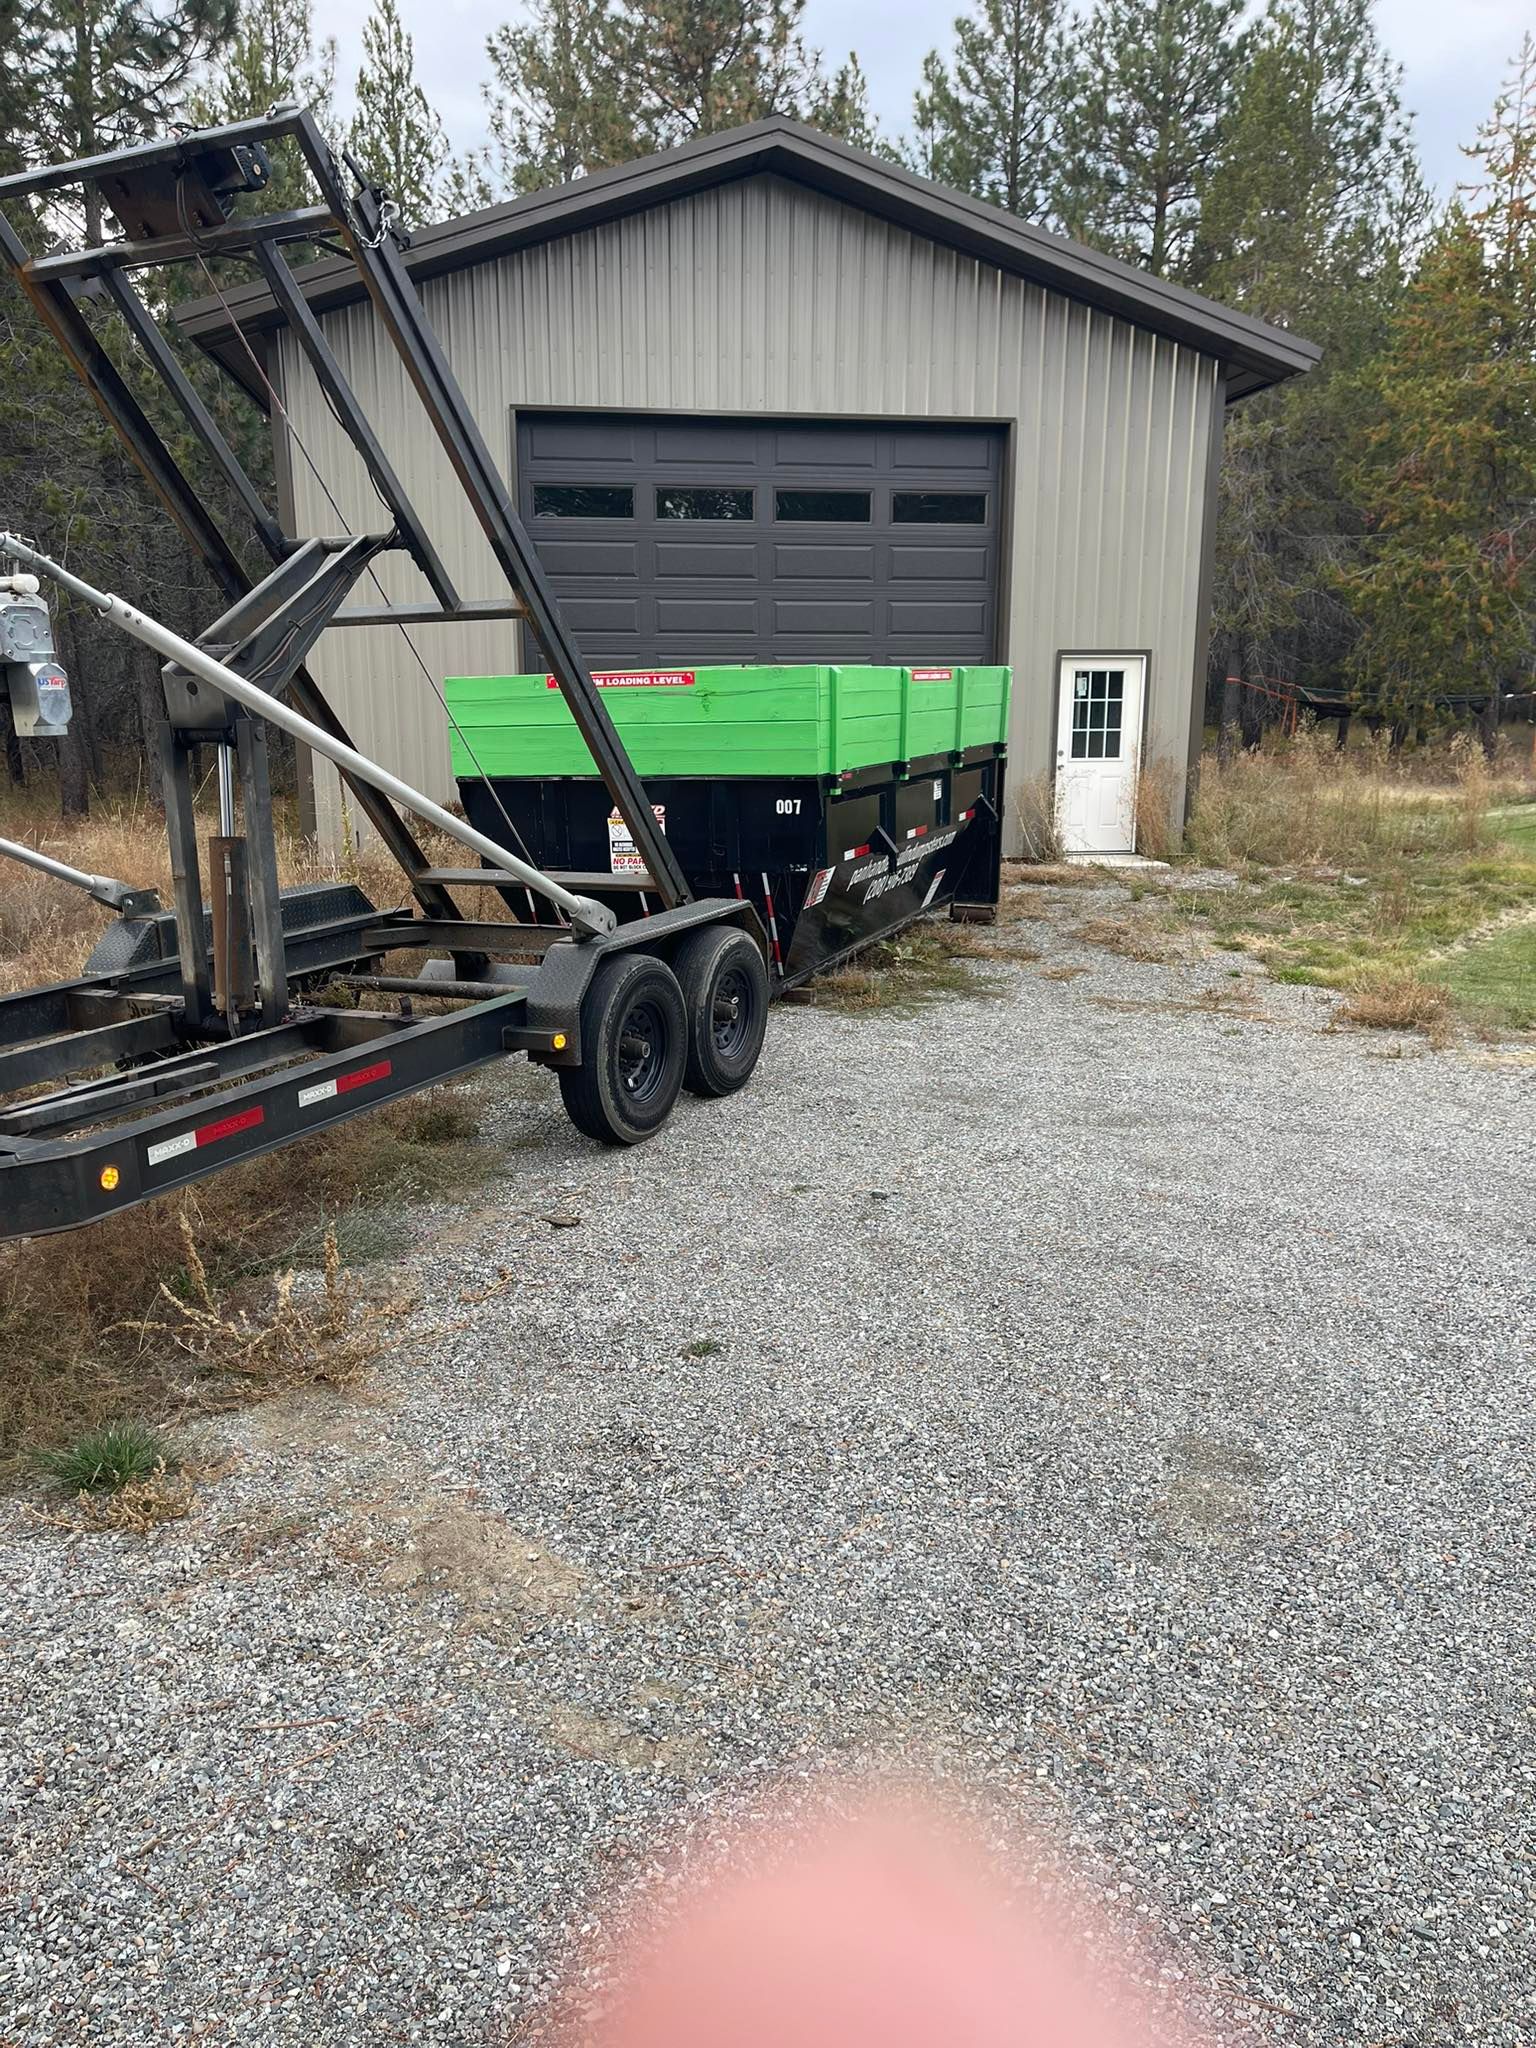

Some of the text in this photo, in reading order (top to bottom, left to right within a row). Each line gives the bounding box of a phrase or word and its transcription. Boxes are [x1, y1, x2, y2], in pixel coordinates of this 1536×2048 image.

[606, 677, 650, 686] LOADING
[653, 676, 686, 685] LEVEL
[775, 799, 802, 815] 007
[303, 1085, 332, 1100] MAXX-D
[154, 1138, 191, 1159] MAXX-D
